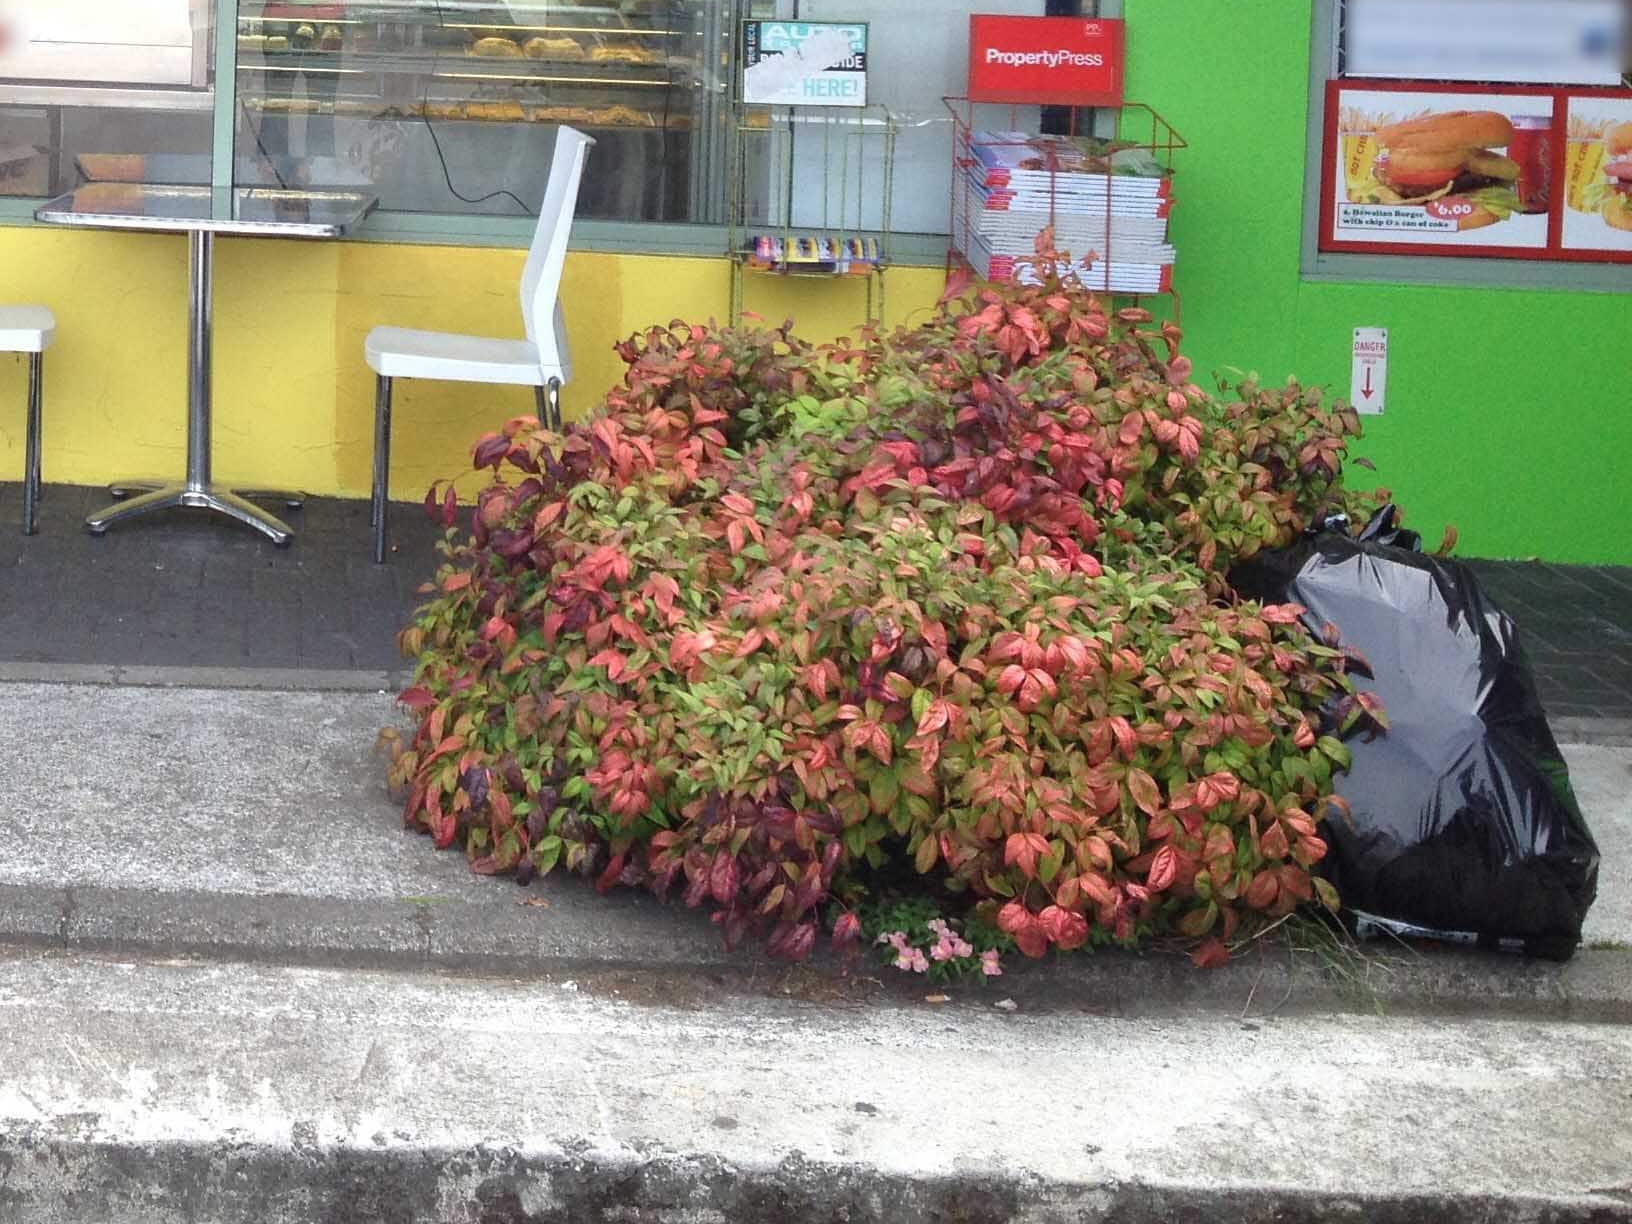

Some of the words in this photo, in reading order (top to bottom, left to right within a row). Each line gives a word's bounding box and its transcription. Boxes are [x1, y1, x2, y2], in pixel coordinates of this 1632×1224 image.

[825, 55, 864, 69] UIDE
[985, 48, 1104, 68] PropertyPress
[802, 78, 859, 97] HERE!
[1354, 342, 1386, 353] DANGER
